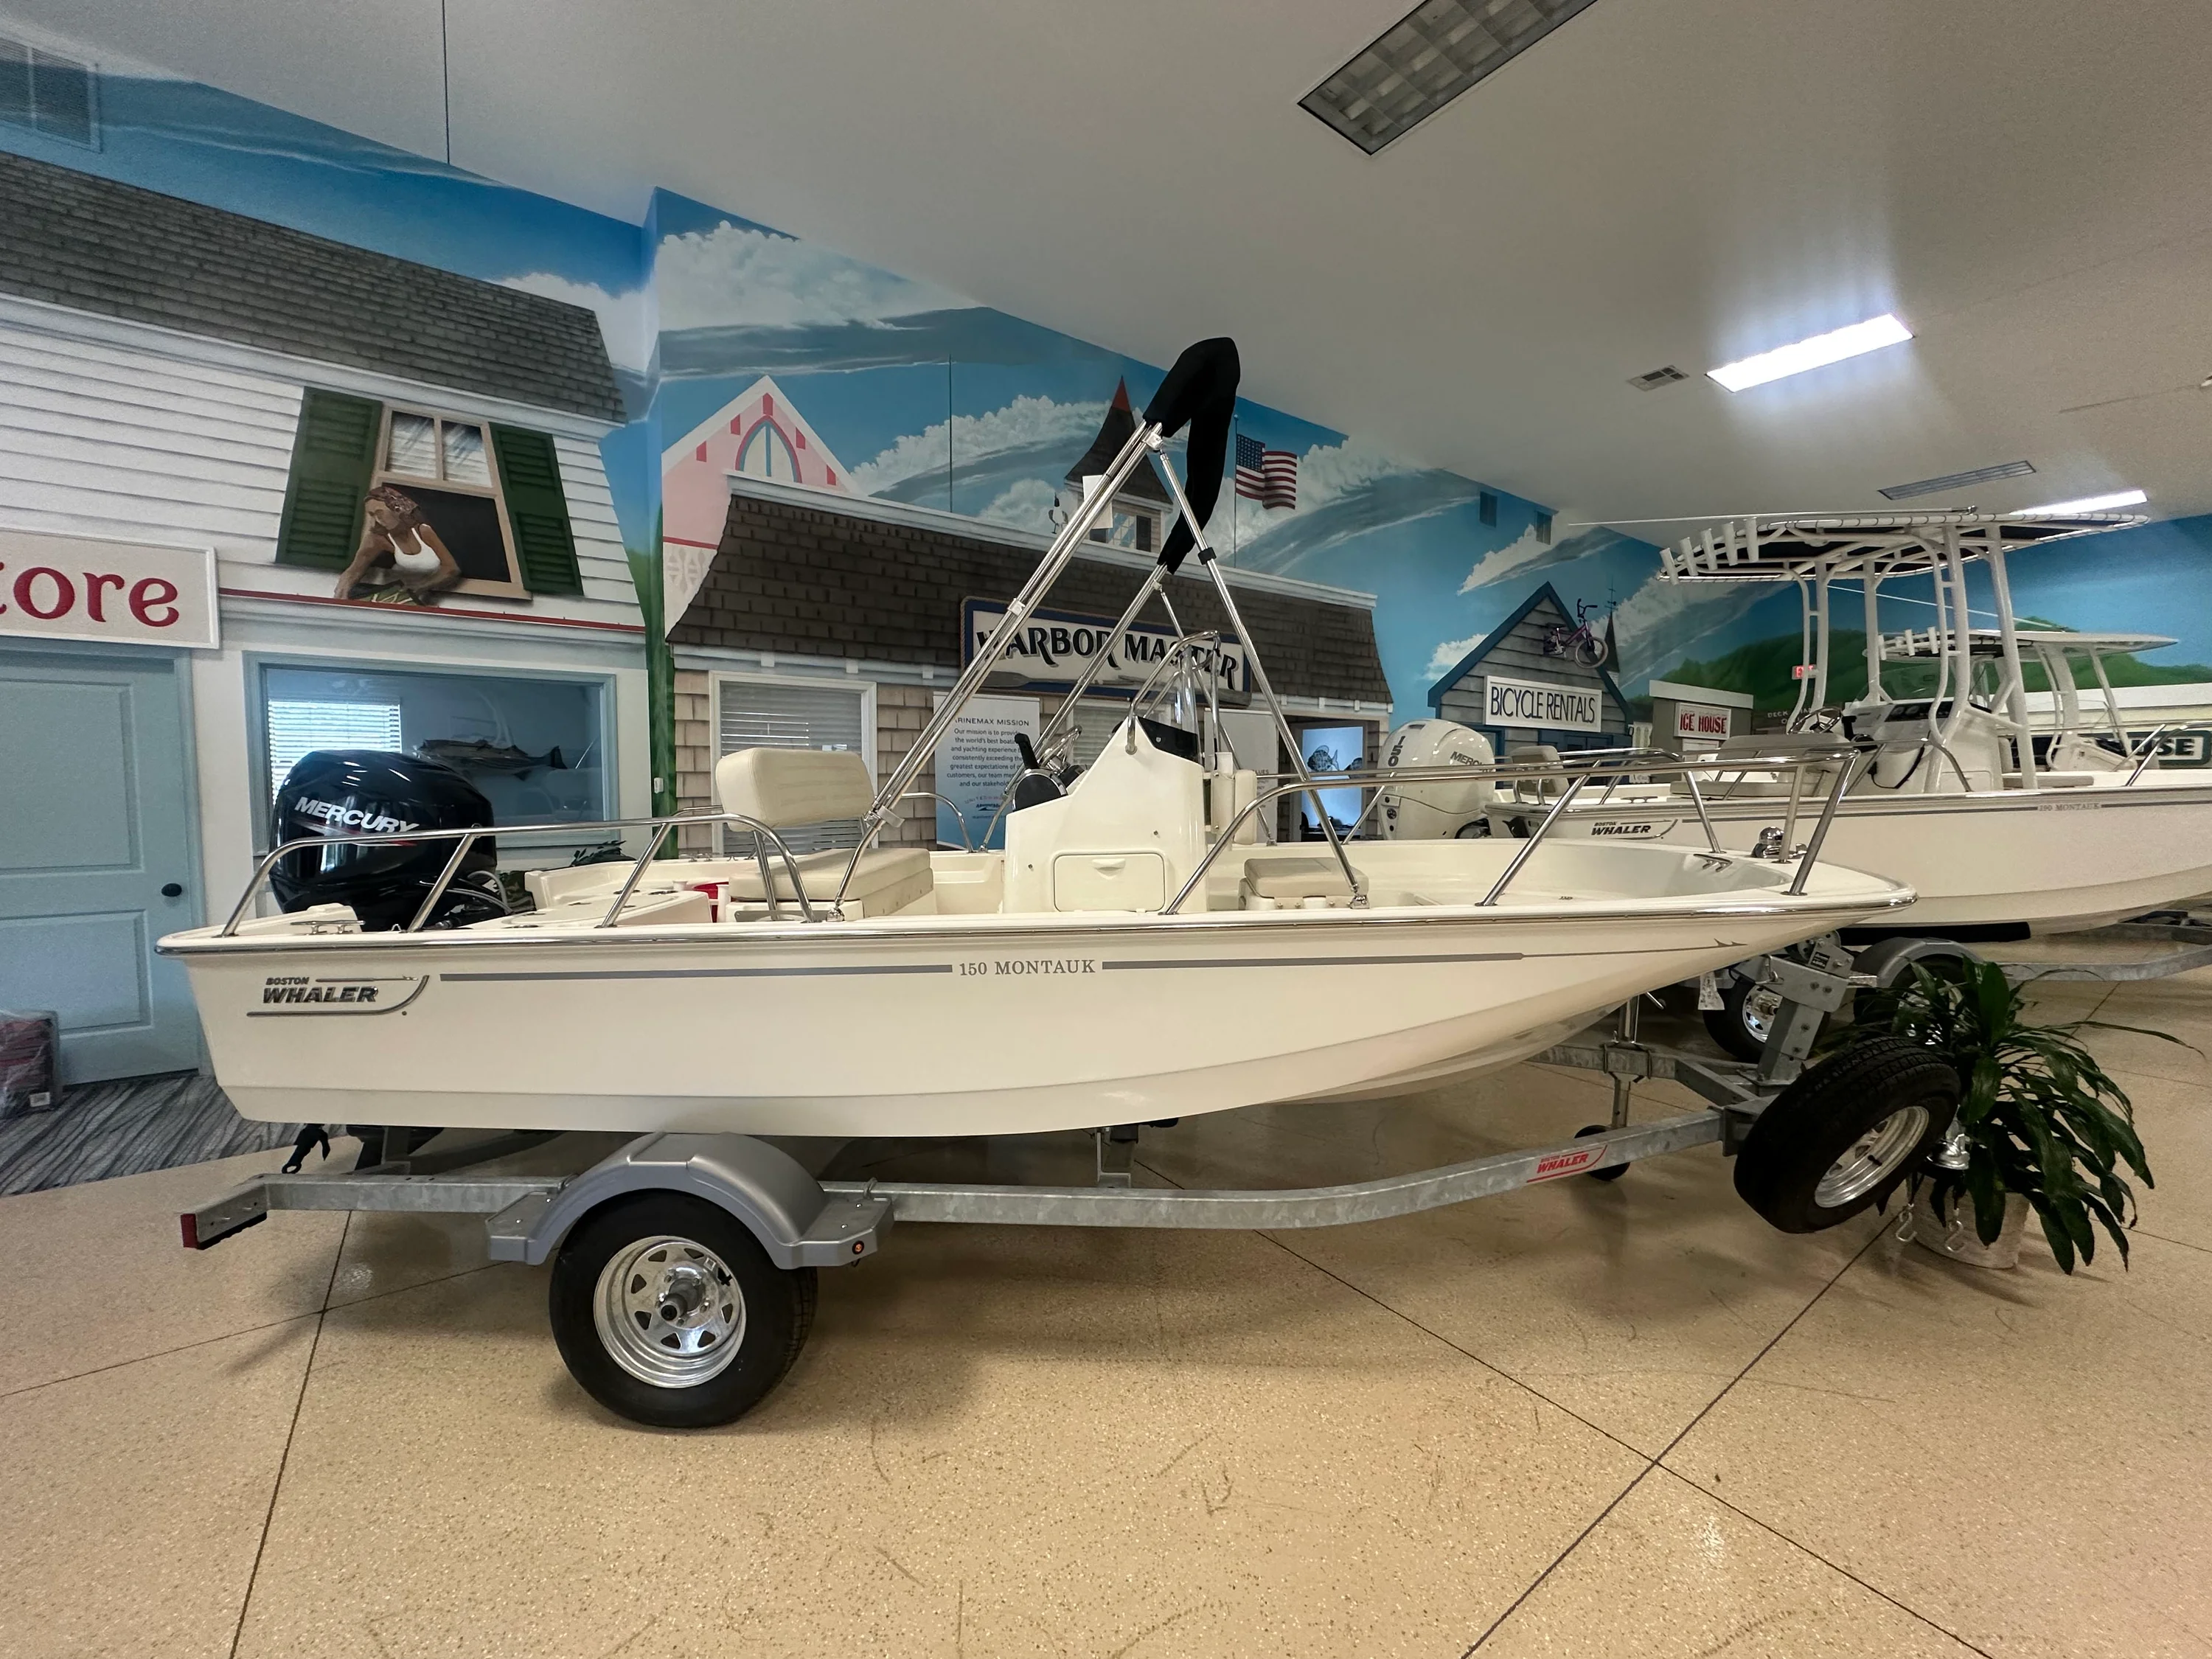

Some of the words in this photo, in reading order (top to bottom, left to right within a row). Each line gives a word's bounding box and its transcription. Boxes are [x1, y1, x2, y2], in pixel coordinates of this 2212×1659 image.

[0, 562, 179, 627] ore
[1491, 686, 1543, 719] BICYCLE
[1546, 692, 1596, 723] RENTALS
[1680, 713, 1695, 731] ICE
[1698, 716, 1727, 734] HOUSE
[1388, 736, 1405, 767] 150
[295, 796, 420, 833] MERCURY
[2056, 803, 2100, 811] MONTAUK
[1591, 825, 1651, 835] WHALER
[959, 961, 988, 976] 150
[995, 959, 1096, 975] MONTAUK
[265, 977, 310, 985] BOSTON
[262, 987, 378, 1004] WHALER
[1537, 1153, 1589, 1173] WHALER
